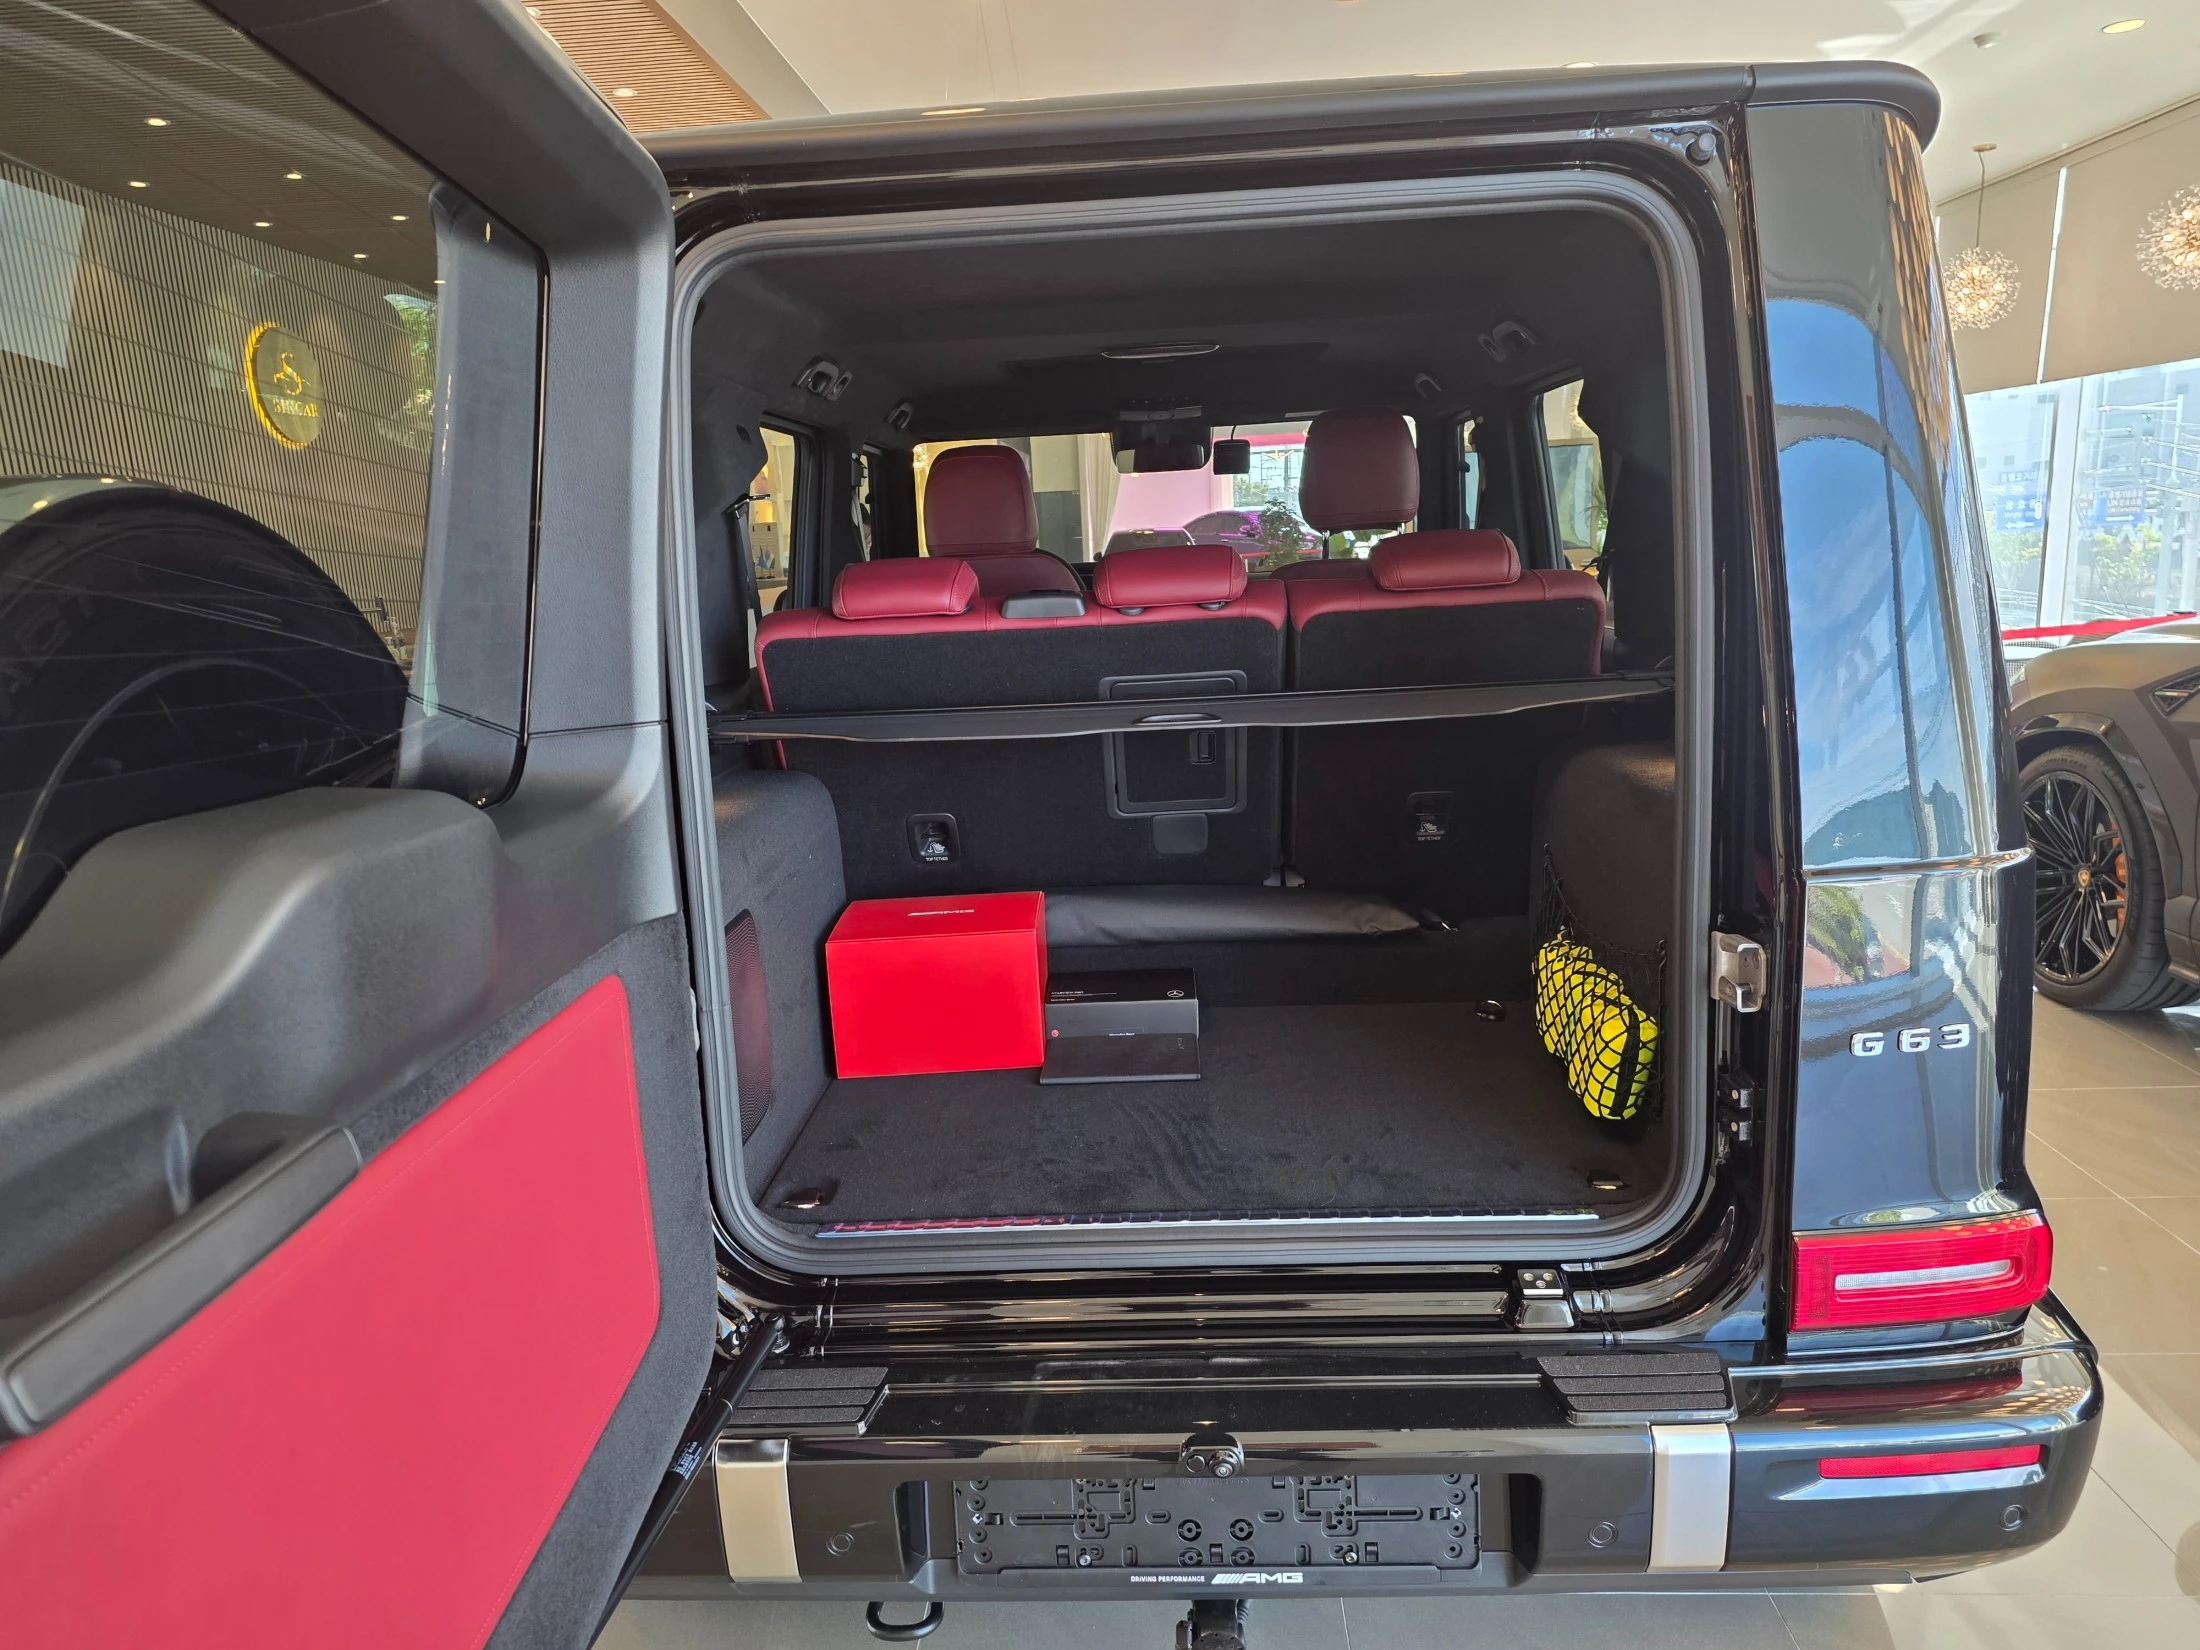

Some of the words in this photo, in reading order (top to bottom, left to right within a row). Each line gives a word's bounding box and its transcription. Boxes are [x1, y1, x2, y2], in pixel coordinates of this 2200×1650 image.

[1849, 1031, 1885, 1057] G
[1897, 1023, 1970, 1053] 63
[1240, 1572, 1304, 1585] AMG
